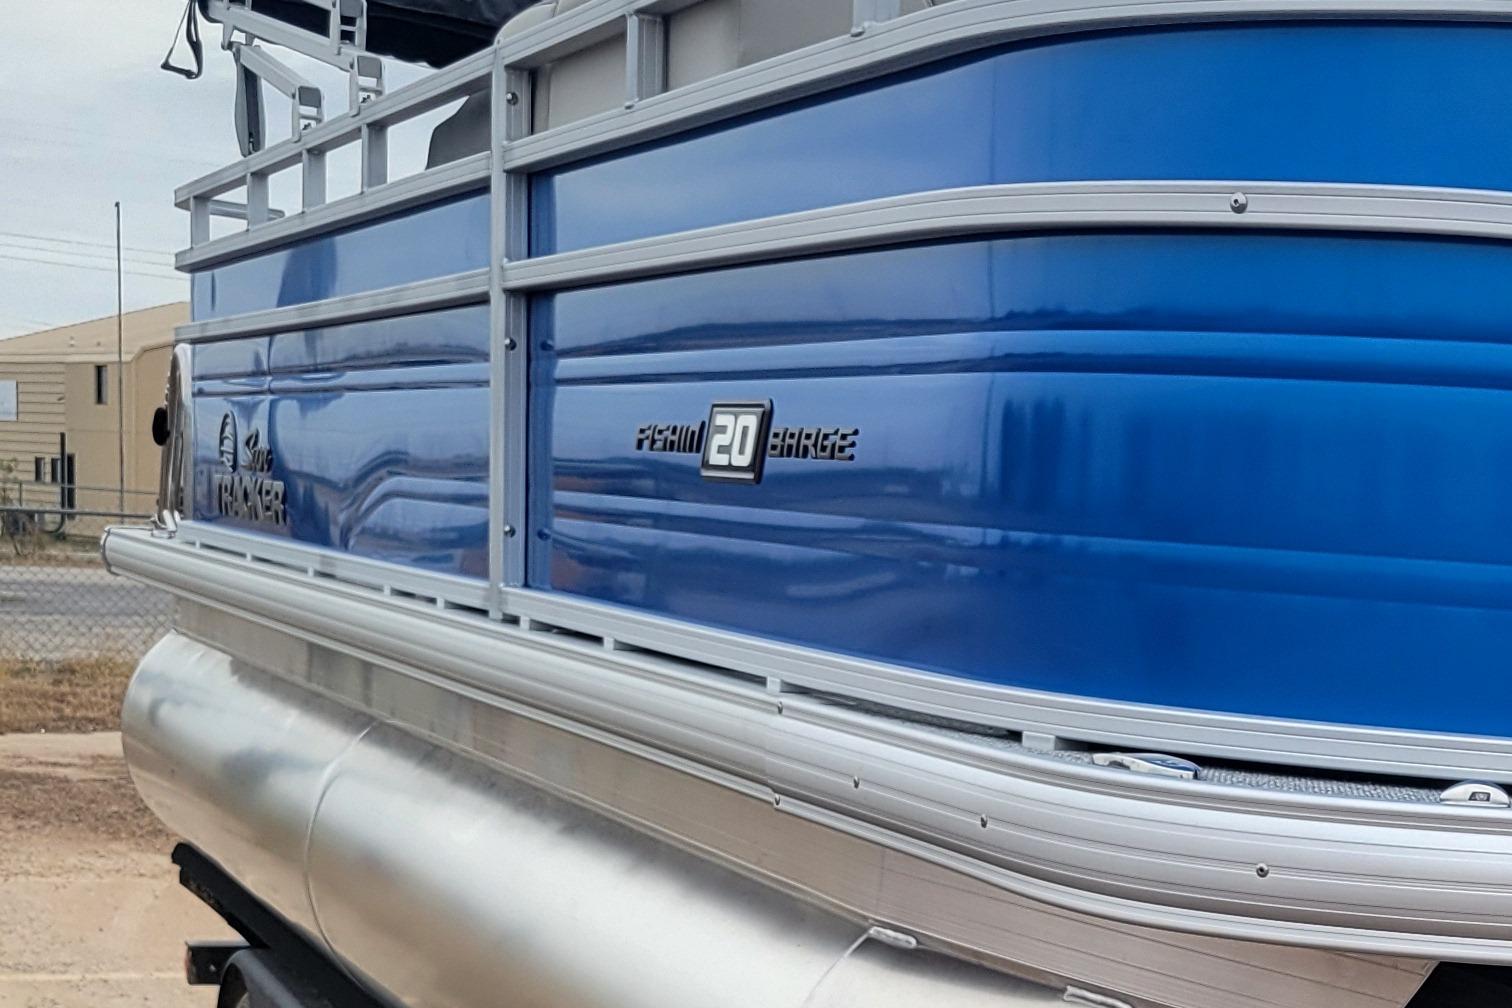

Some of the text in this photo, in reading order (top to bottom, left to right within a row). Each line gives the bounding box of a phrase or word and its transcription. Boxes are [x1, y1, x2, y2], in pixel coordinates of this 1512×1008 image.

[708, 413, 758, 467] 20
[768, 428, 859, 461] BARGE
[215, 473, 288, 526] TRACKER
